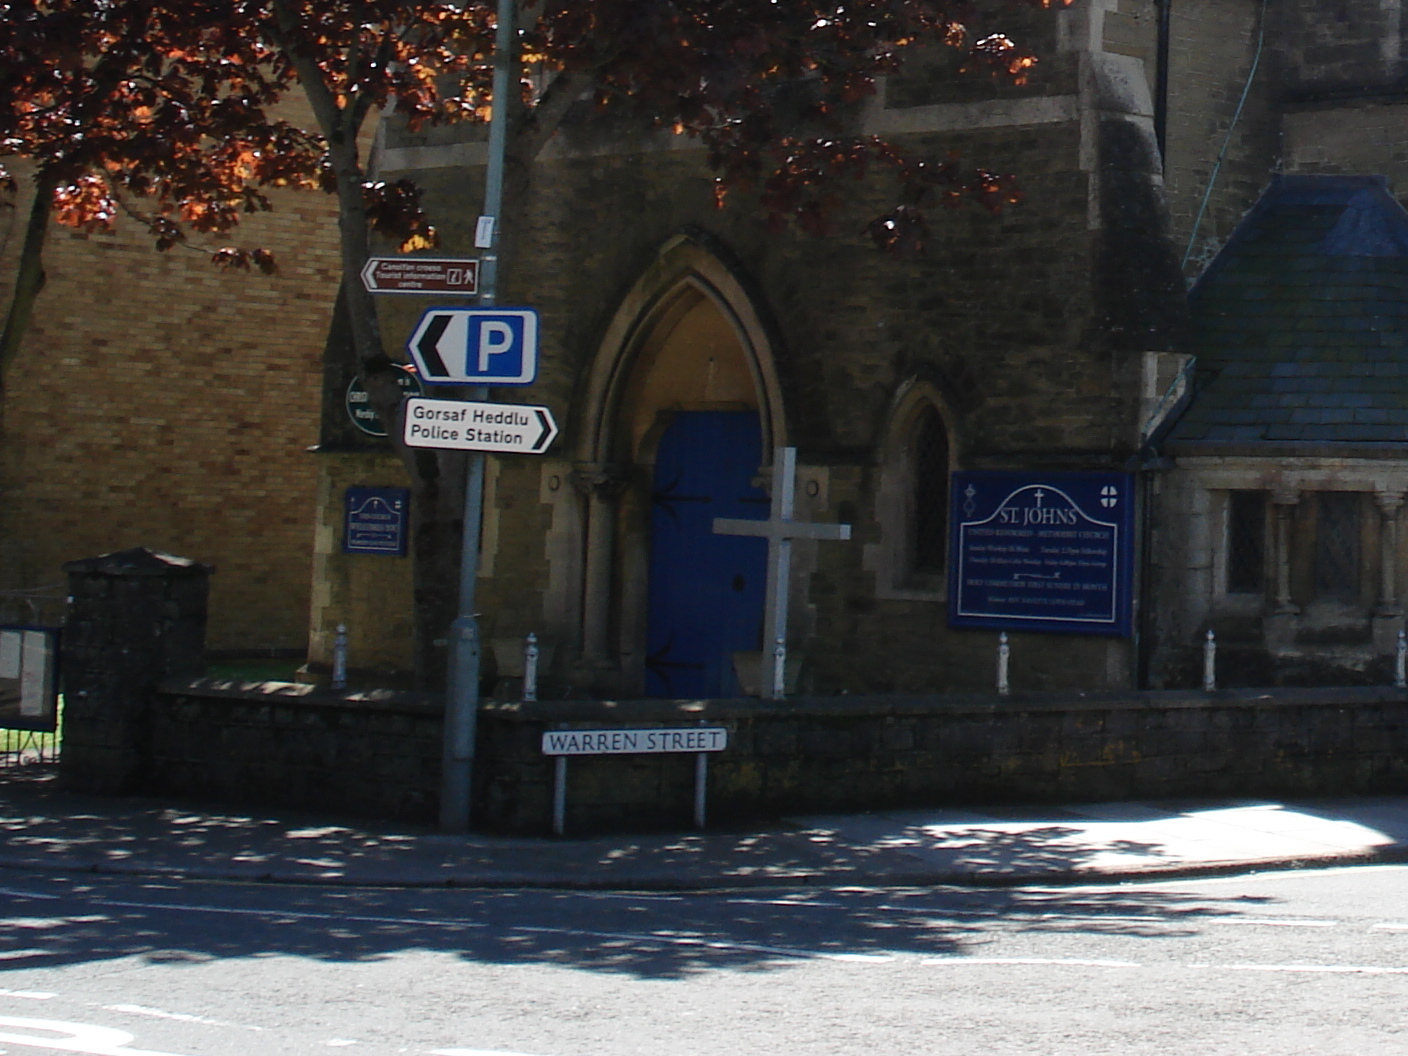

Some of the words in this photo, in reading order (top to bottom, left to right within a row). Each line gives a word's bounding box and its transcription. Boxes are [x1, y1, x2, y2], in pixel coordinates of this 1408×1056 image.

[376, 271, 402, 279] Tourist
[477, 320, 515, 372] P
[413, 406, 467, 422] Gorsaf
[472, 409, 529, 426] Heddlu
[410, 425, 459, 441] Police
[464, 428, 523, 445] Station
[1023, 507, 1078, 526] JOHNS
[550, 732, 638, 751] WARREN
[647, 731, 721, 750] STREET
